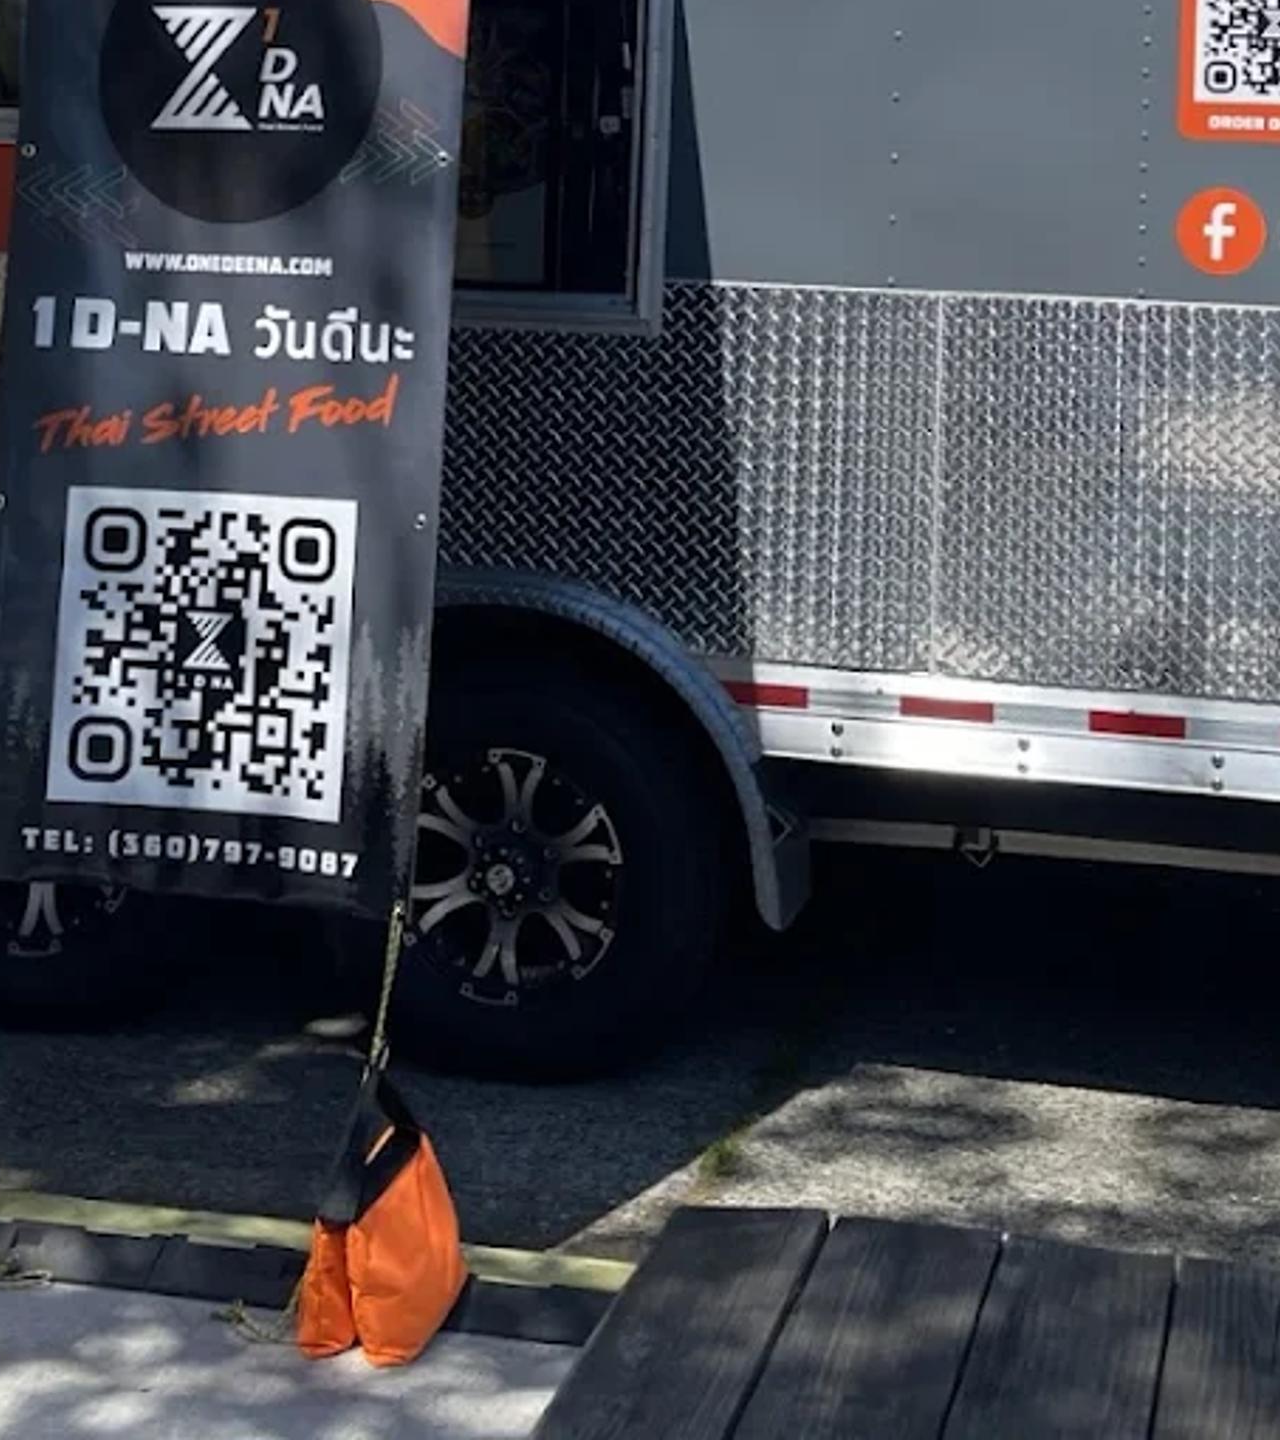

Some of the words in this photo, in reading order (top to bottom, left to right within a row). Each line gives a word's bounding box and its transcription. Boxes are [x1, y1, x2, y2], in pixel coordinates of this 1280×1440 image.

[258, 48, 298, 82] D
[258, 84, 325, 119] NA
[1208, 115, 1266, 130] ORDER
[32, 296, 56, 348] 1
[70, 296, 231, 356] D-NA
[253, 303, 415, 363] วันดีนะ
[34, 403, 132, 453] Thai
[140, 387, 279, 445] Street
[287, 372, 400, 435] Food
[22, 827, 94, 853] TEL:
[107, 829, 359, 878] (360)797-9087
